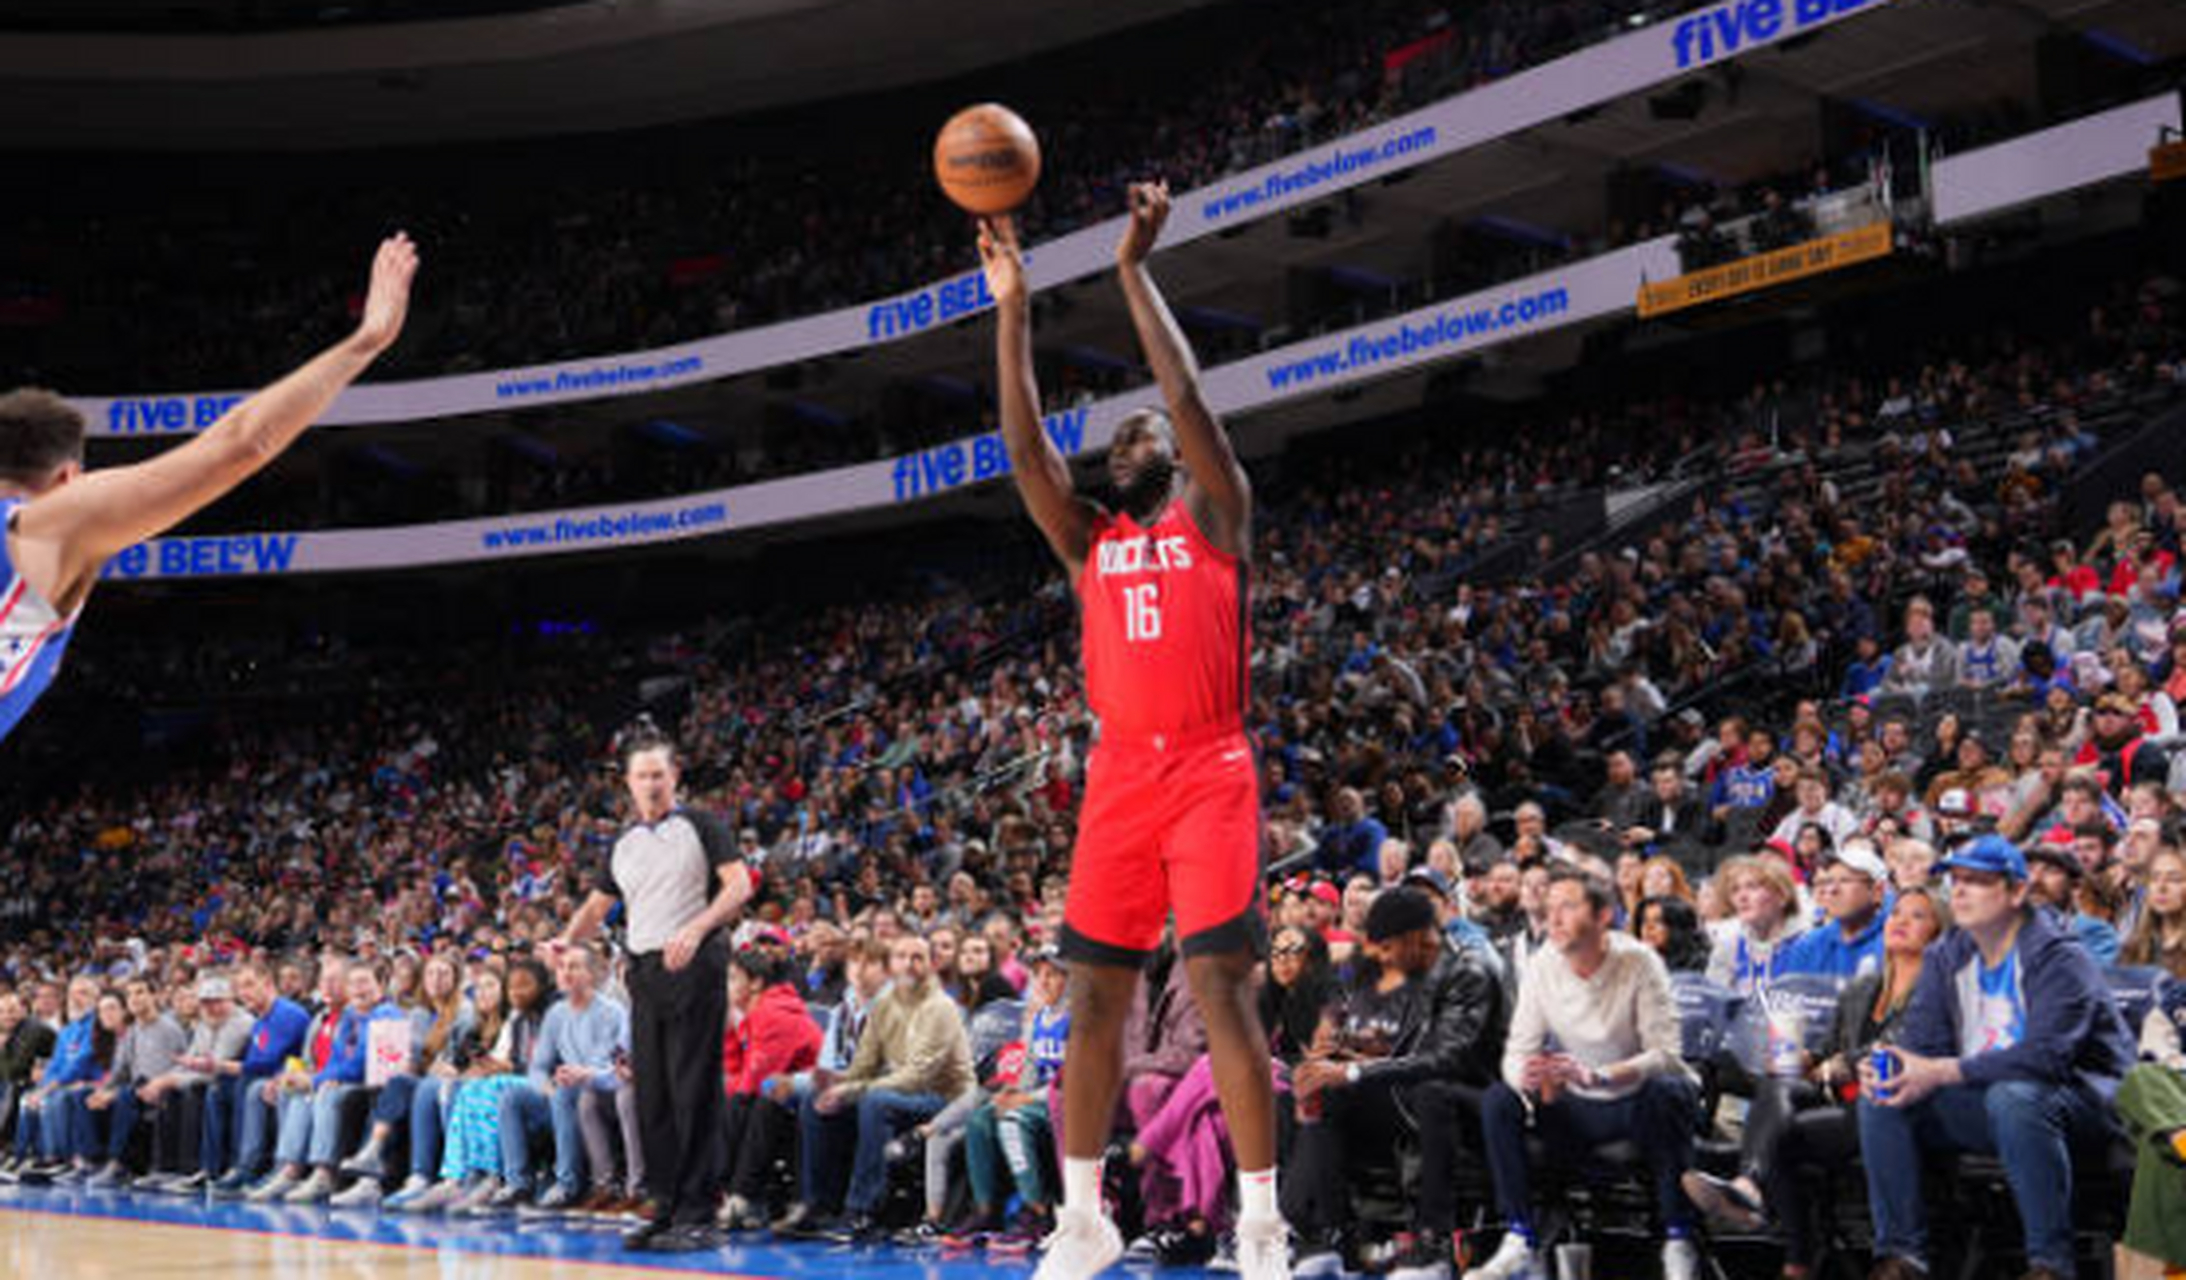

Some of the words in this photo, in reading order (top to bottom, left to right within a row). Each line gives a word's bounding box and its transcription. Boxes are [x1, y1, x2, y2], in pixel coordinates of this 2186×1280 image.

[1672, 0, 1780, 69] five
[1203, 126, 1437, 220] www.fivebelow.com
[868, 293, 933, 339] five
[938, 271, 996, 321] BEL
[1266, 286, 1570, 390] www.fivebelow.com
[108, 398, 188, 433] five
[892, 444, 966, 503] five
[483, 503, 727, 549] www.fivebelow.com
[1123, 584, 1161, 641] 16
